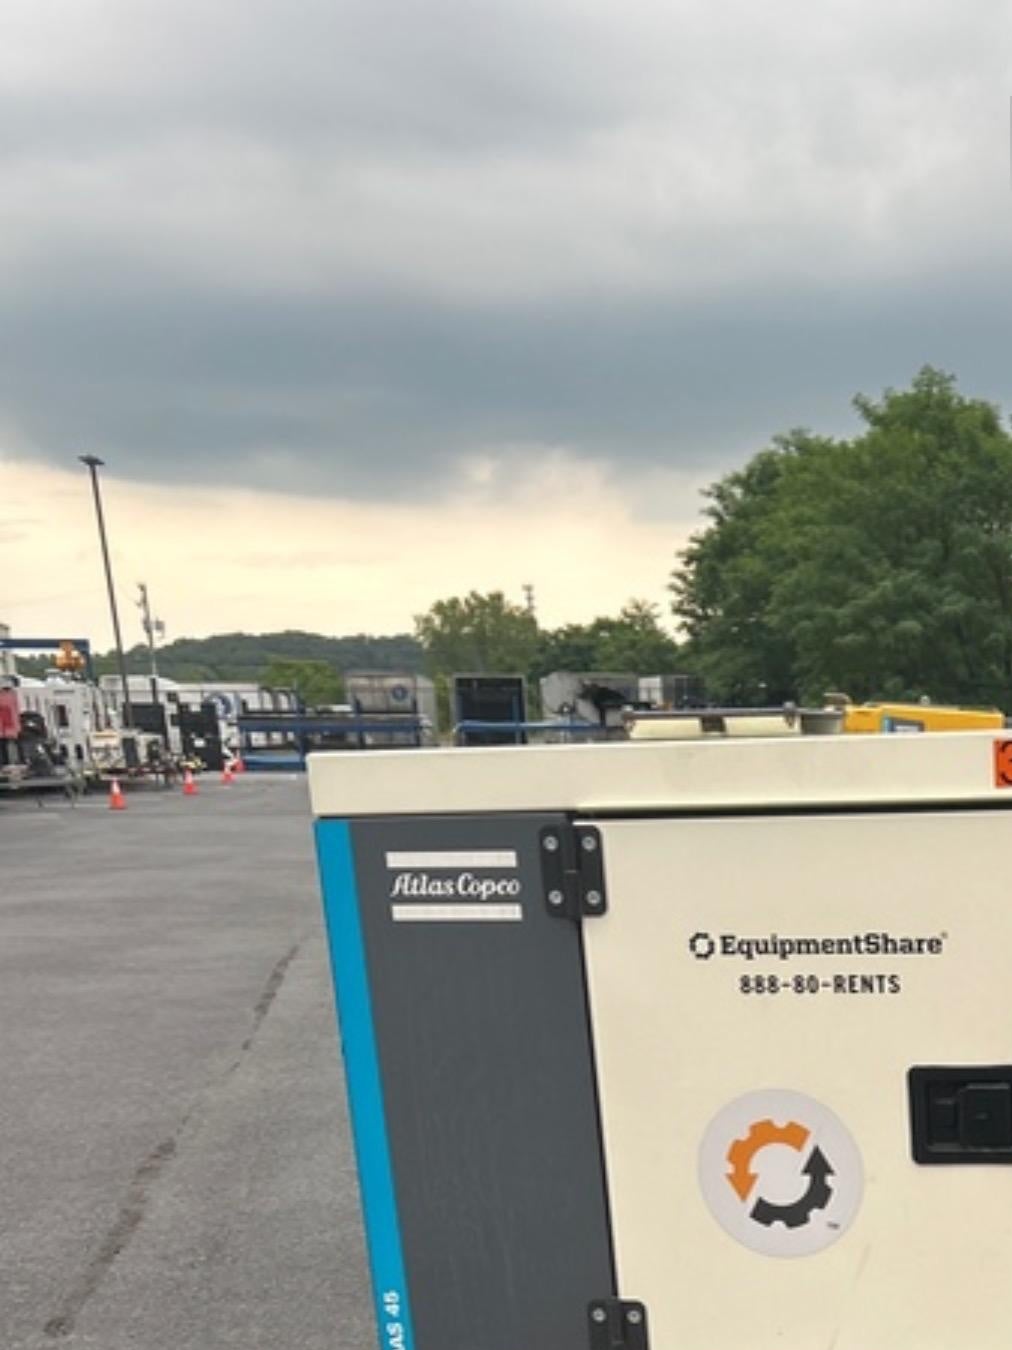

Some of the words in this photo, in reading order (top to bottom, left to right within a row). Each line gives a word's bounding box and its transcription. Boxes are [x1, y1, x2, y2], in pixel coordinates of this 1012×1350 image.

[389, 872, 454, 898] Atlas
[457, 871, 521, 900] Copco
[739, 974, 901, 994] 888-80-RENTS
[383, 1289, 400, 1318] 45
